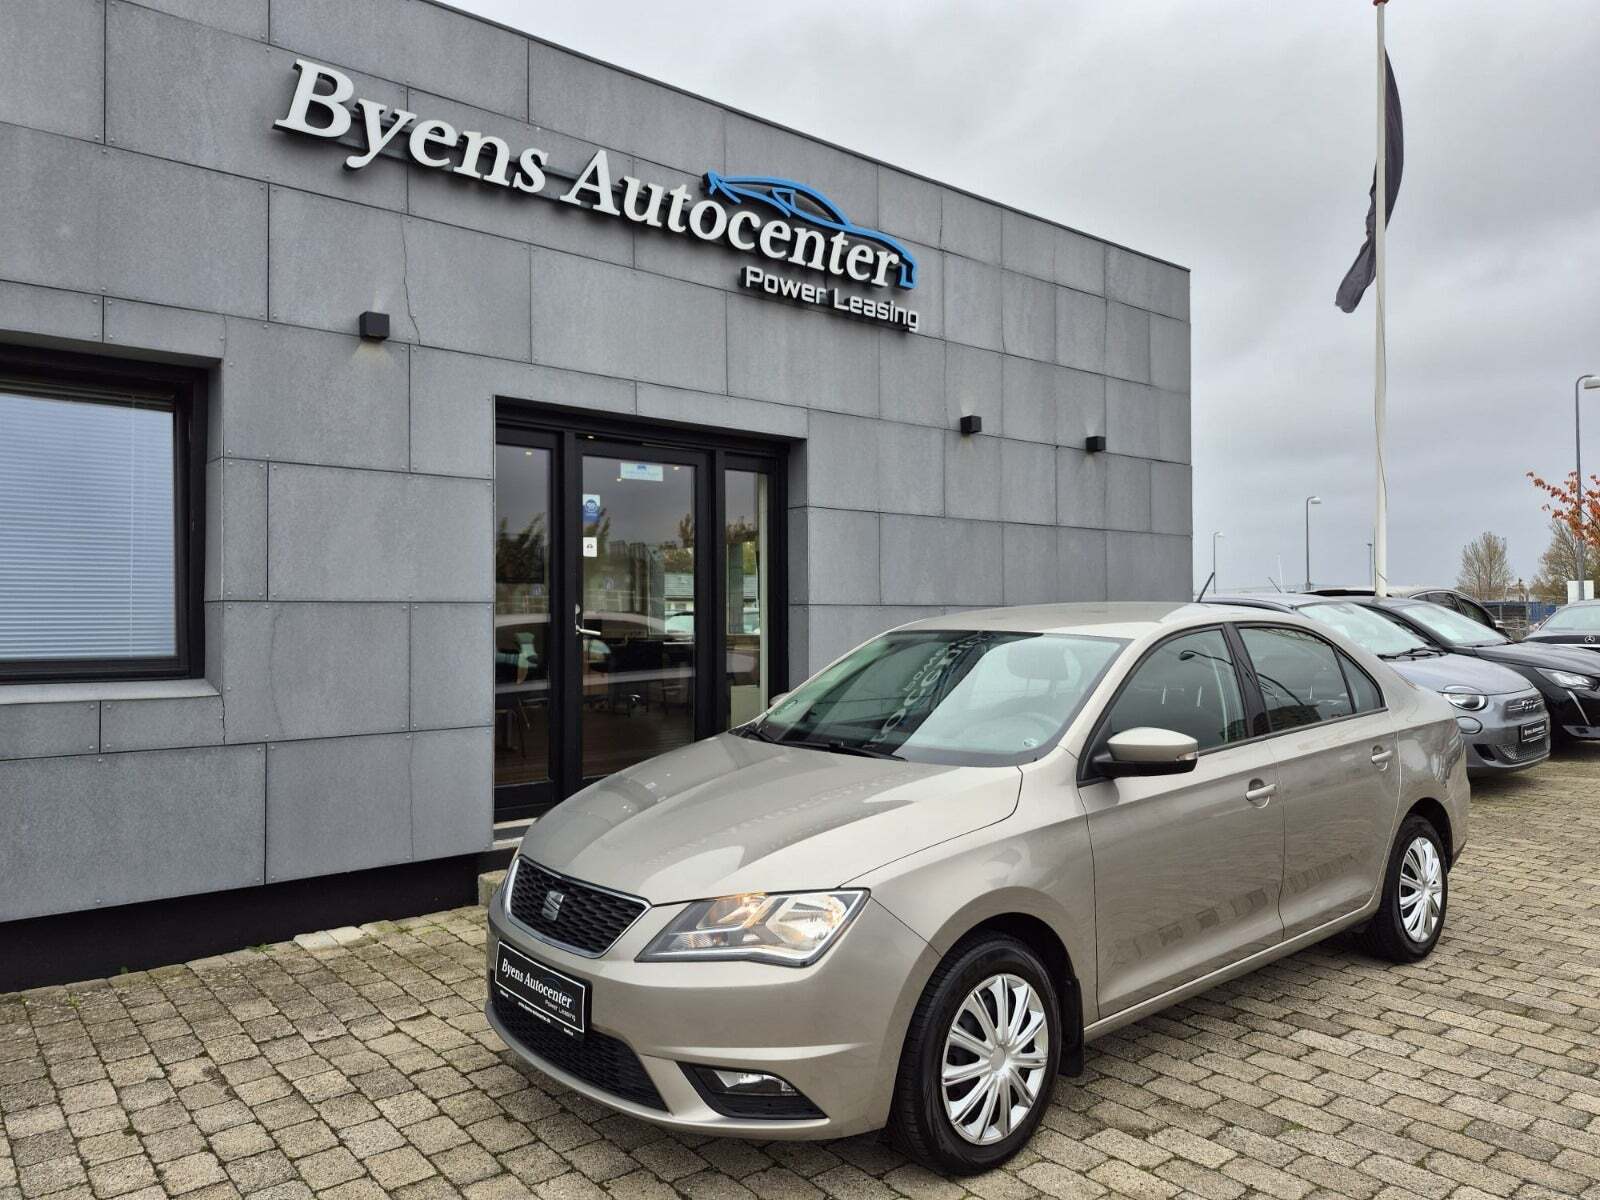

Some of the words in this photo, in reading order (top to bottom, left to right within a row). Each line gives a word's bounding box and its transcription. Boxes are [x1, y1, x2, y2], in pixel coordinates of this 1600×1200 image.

[274, 58, 549, 194] Byens
[559, 149, 900, 288] Autocenter
[744, 265, 827, 305] Power
[832, 287, 920, 333] Leasing
[501, 958, 524, 983] Byens
[523, 972, 573, 1009] Autocenter
